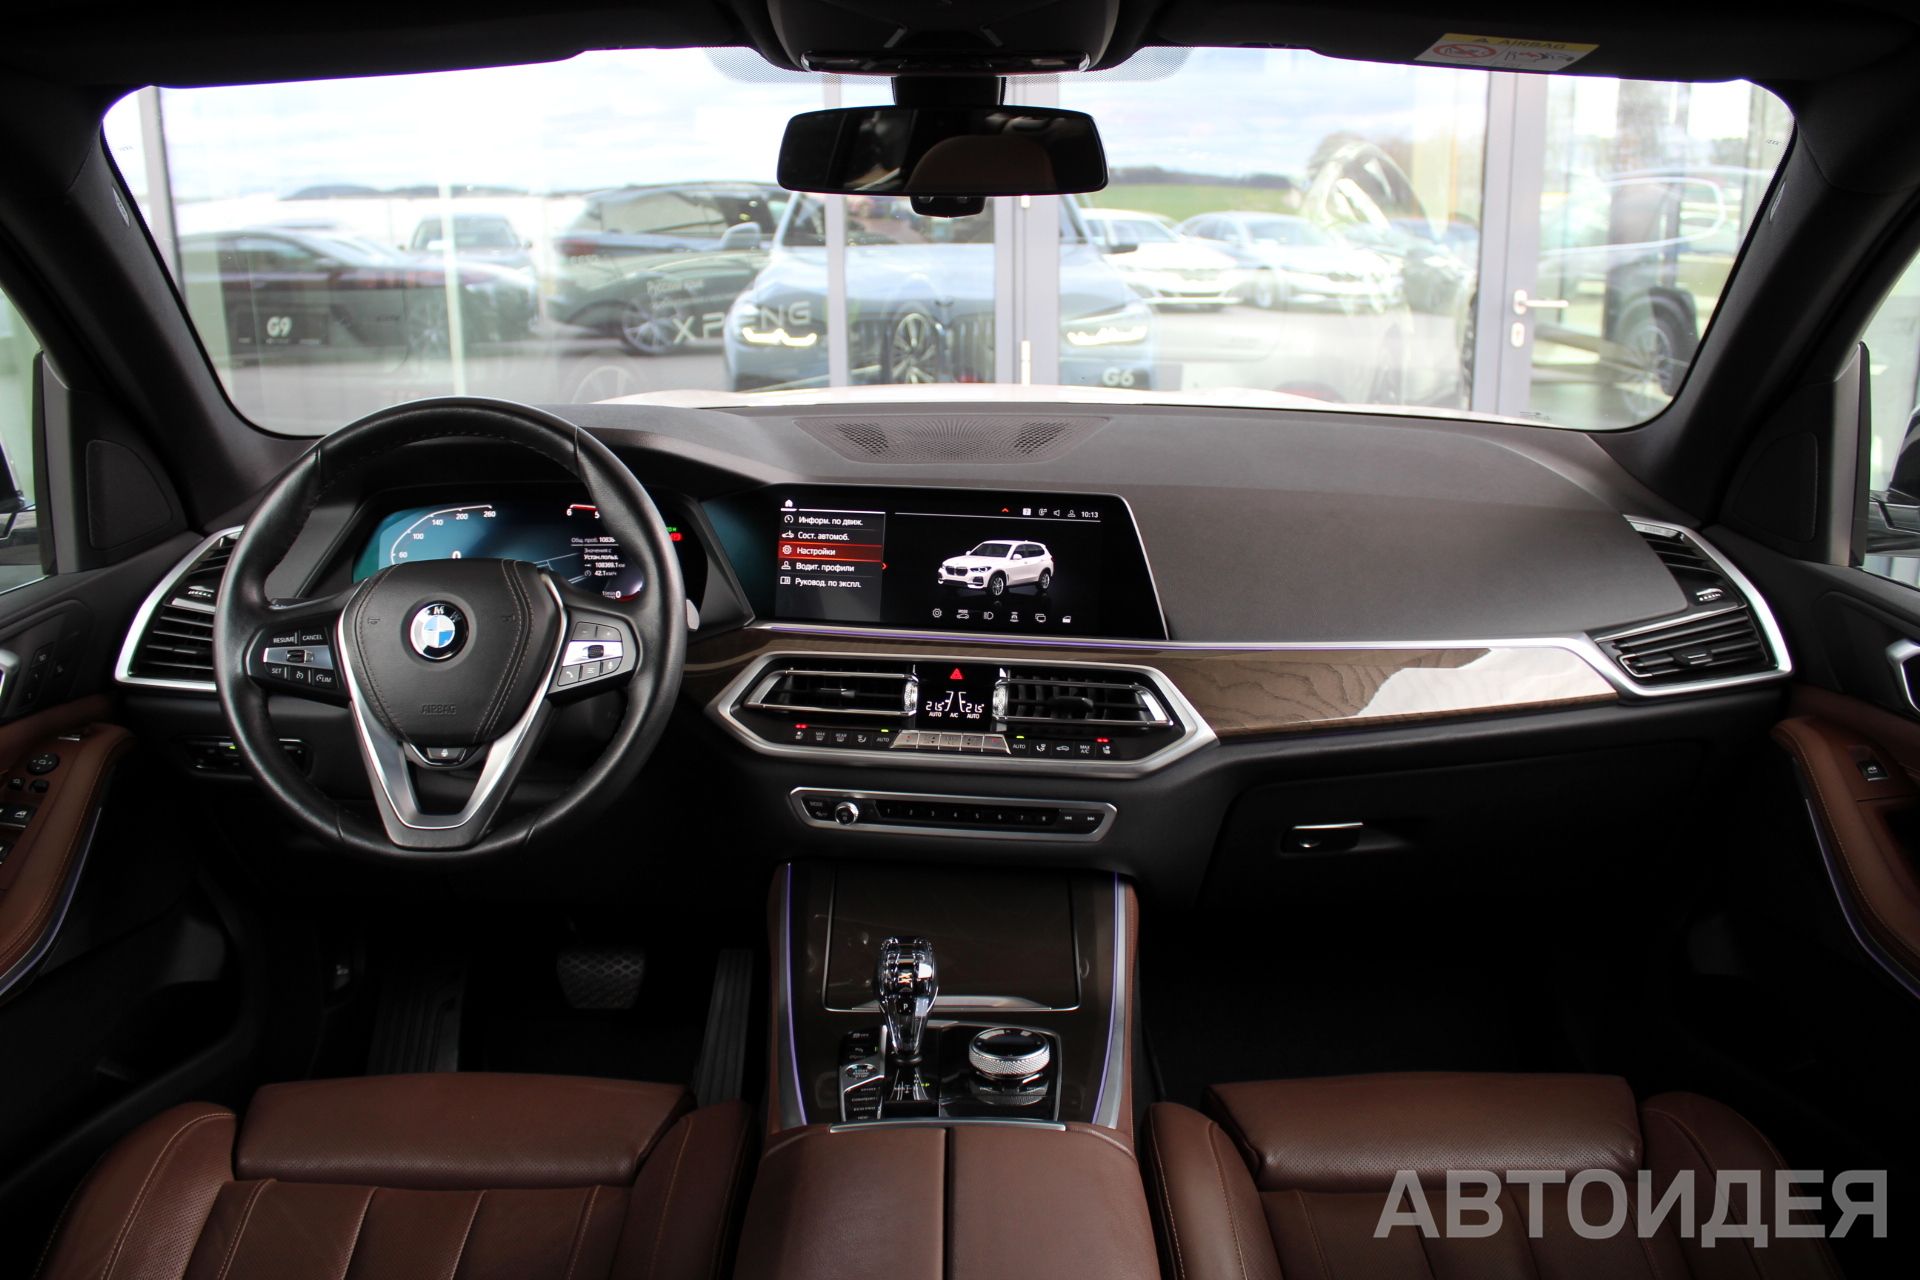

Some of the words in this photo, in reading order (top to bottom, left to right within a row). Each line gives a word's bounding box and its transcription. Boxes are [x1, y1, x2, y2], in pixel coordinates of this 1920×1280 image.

[1502, 39, 1567, 49] AIRBAG
[266, 316, 292, 337] G9
[1103, 366, 1136, 387] G6
[456, 512, 468, 520] 200
[483, 510, 496, 518] 260
[798, 516, 830, 525] Информ.
[798, 532, 816, 540] Сост.
[818, 533, 849, 541] автомоб.
[797, 547, 836, 555] Настройки
[796, 563, 820, 571] Водит.
[795, 578, 826, 587] Руковод.
[615, 590, 622, 598] 0
[421, 704, 456, 715] AIRBAG
